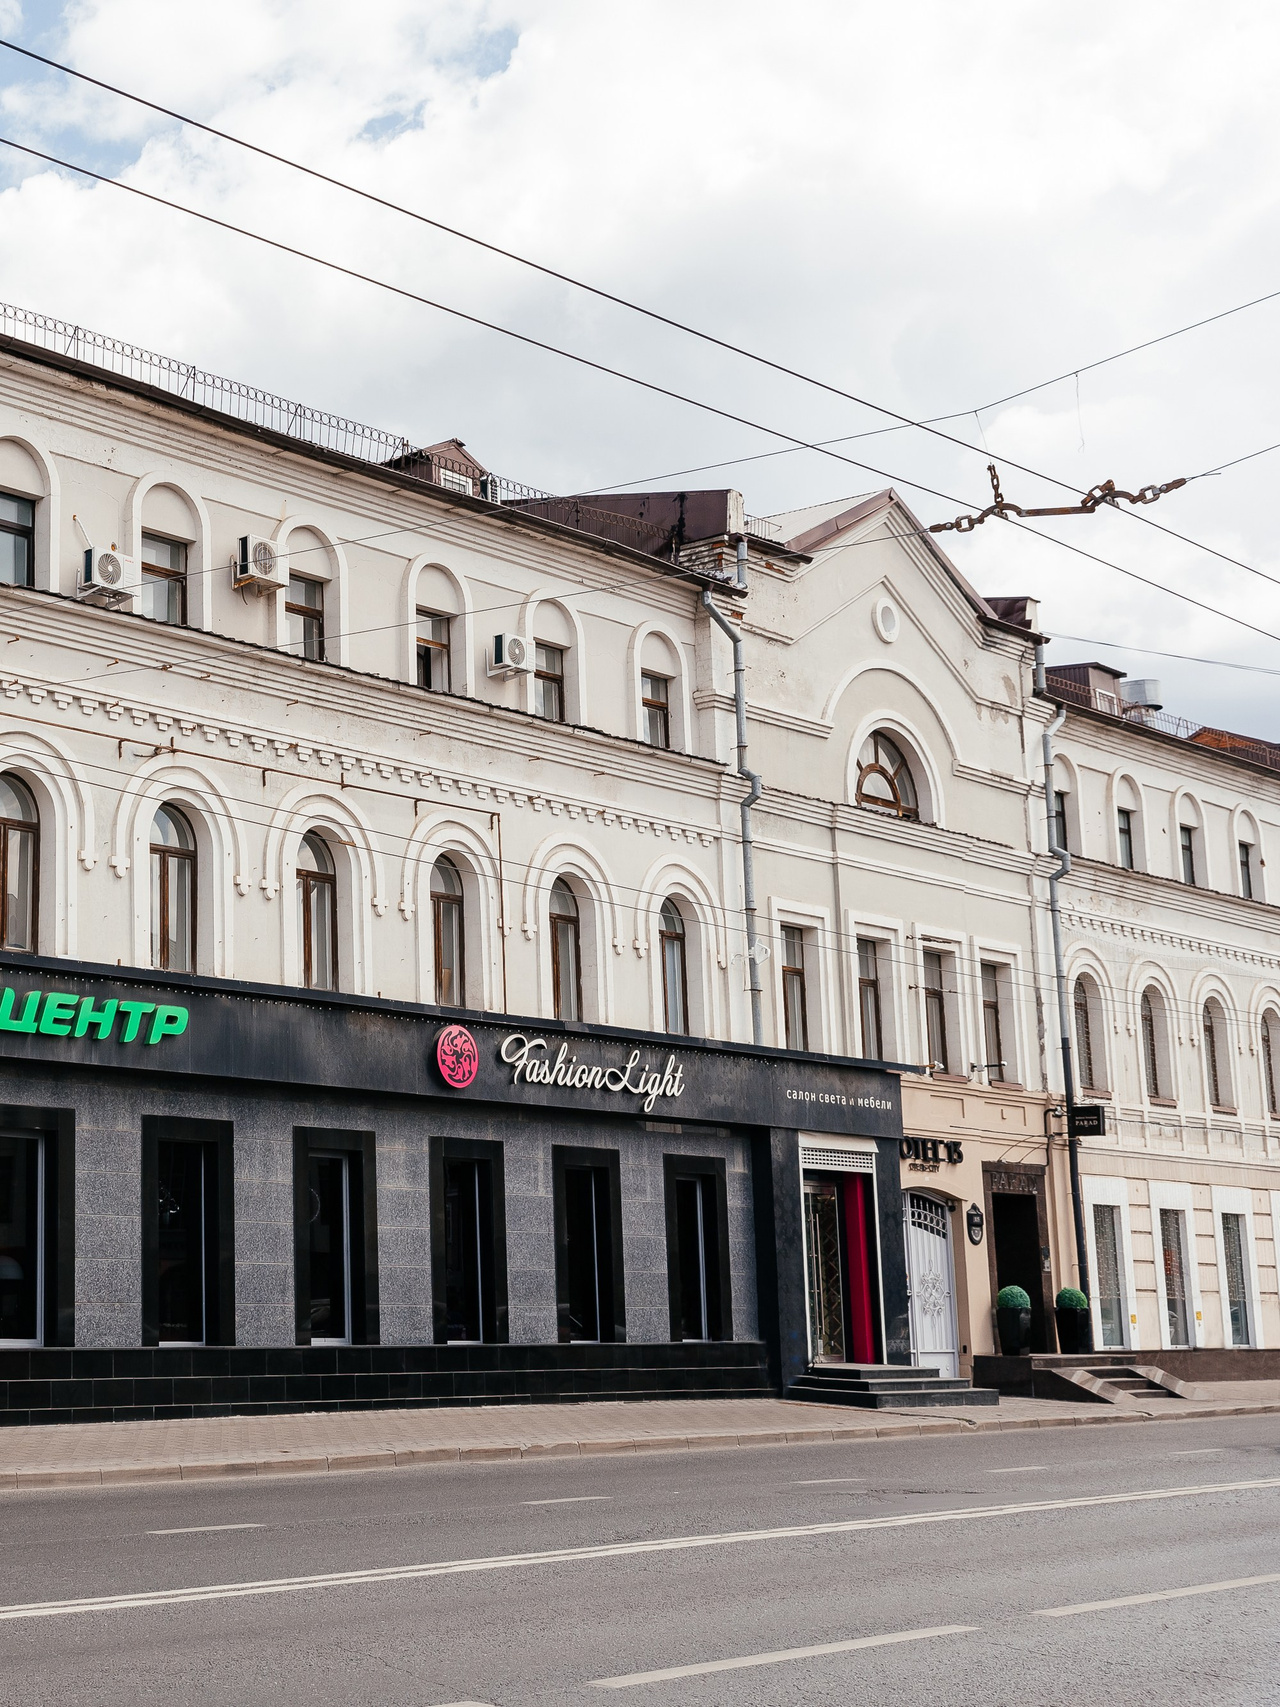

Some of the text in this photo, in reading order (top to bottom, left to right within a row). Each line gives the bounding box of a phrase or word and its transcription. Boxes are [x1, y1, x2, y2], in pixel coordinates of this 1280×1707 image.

[786, 1089, 892, 1110] салон света и мебели
